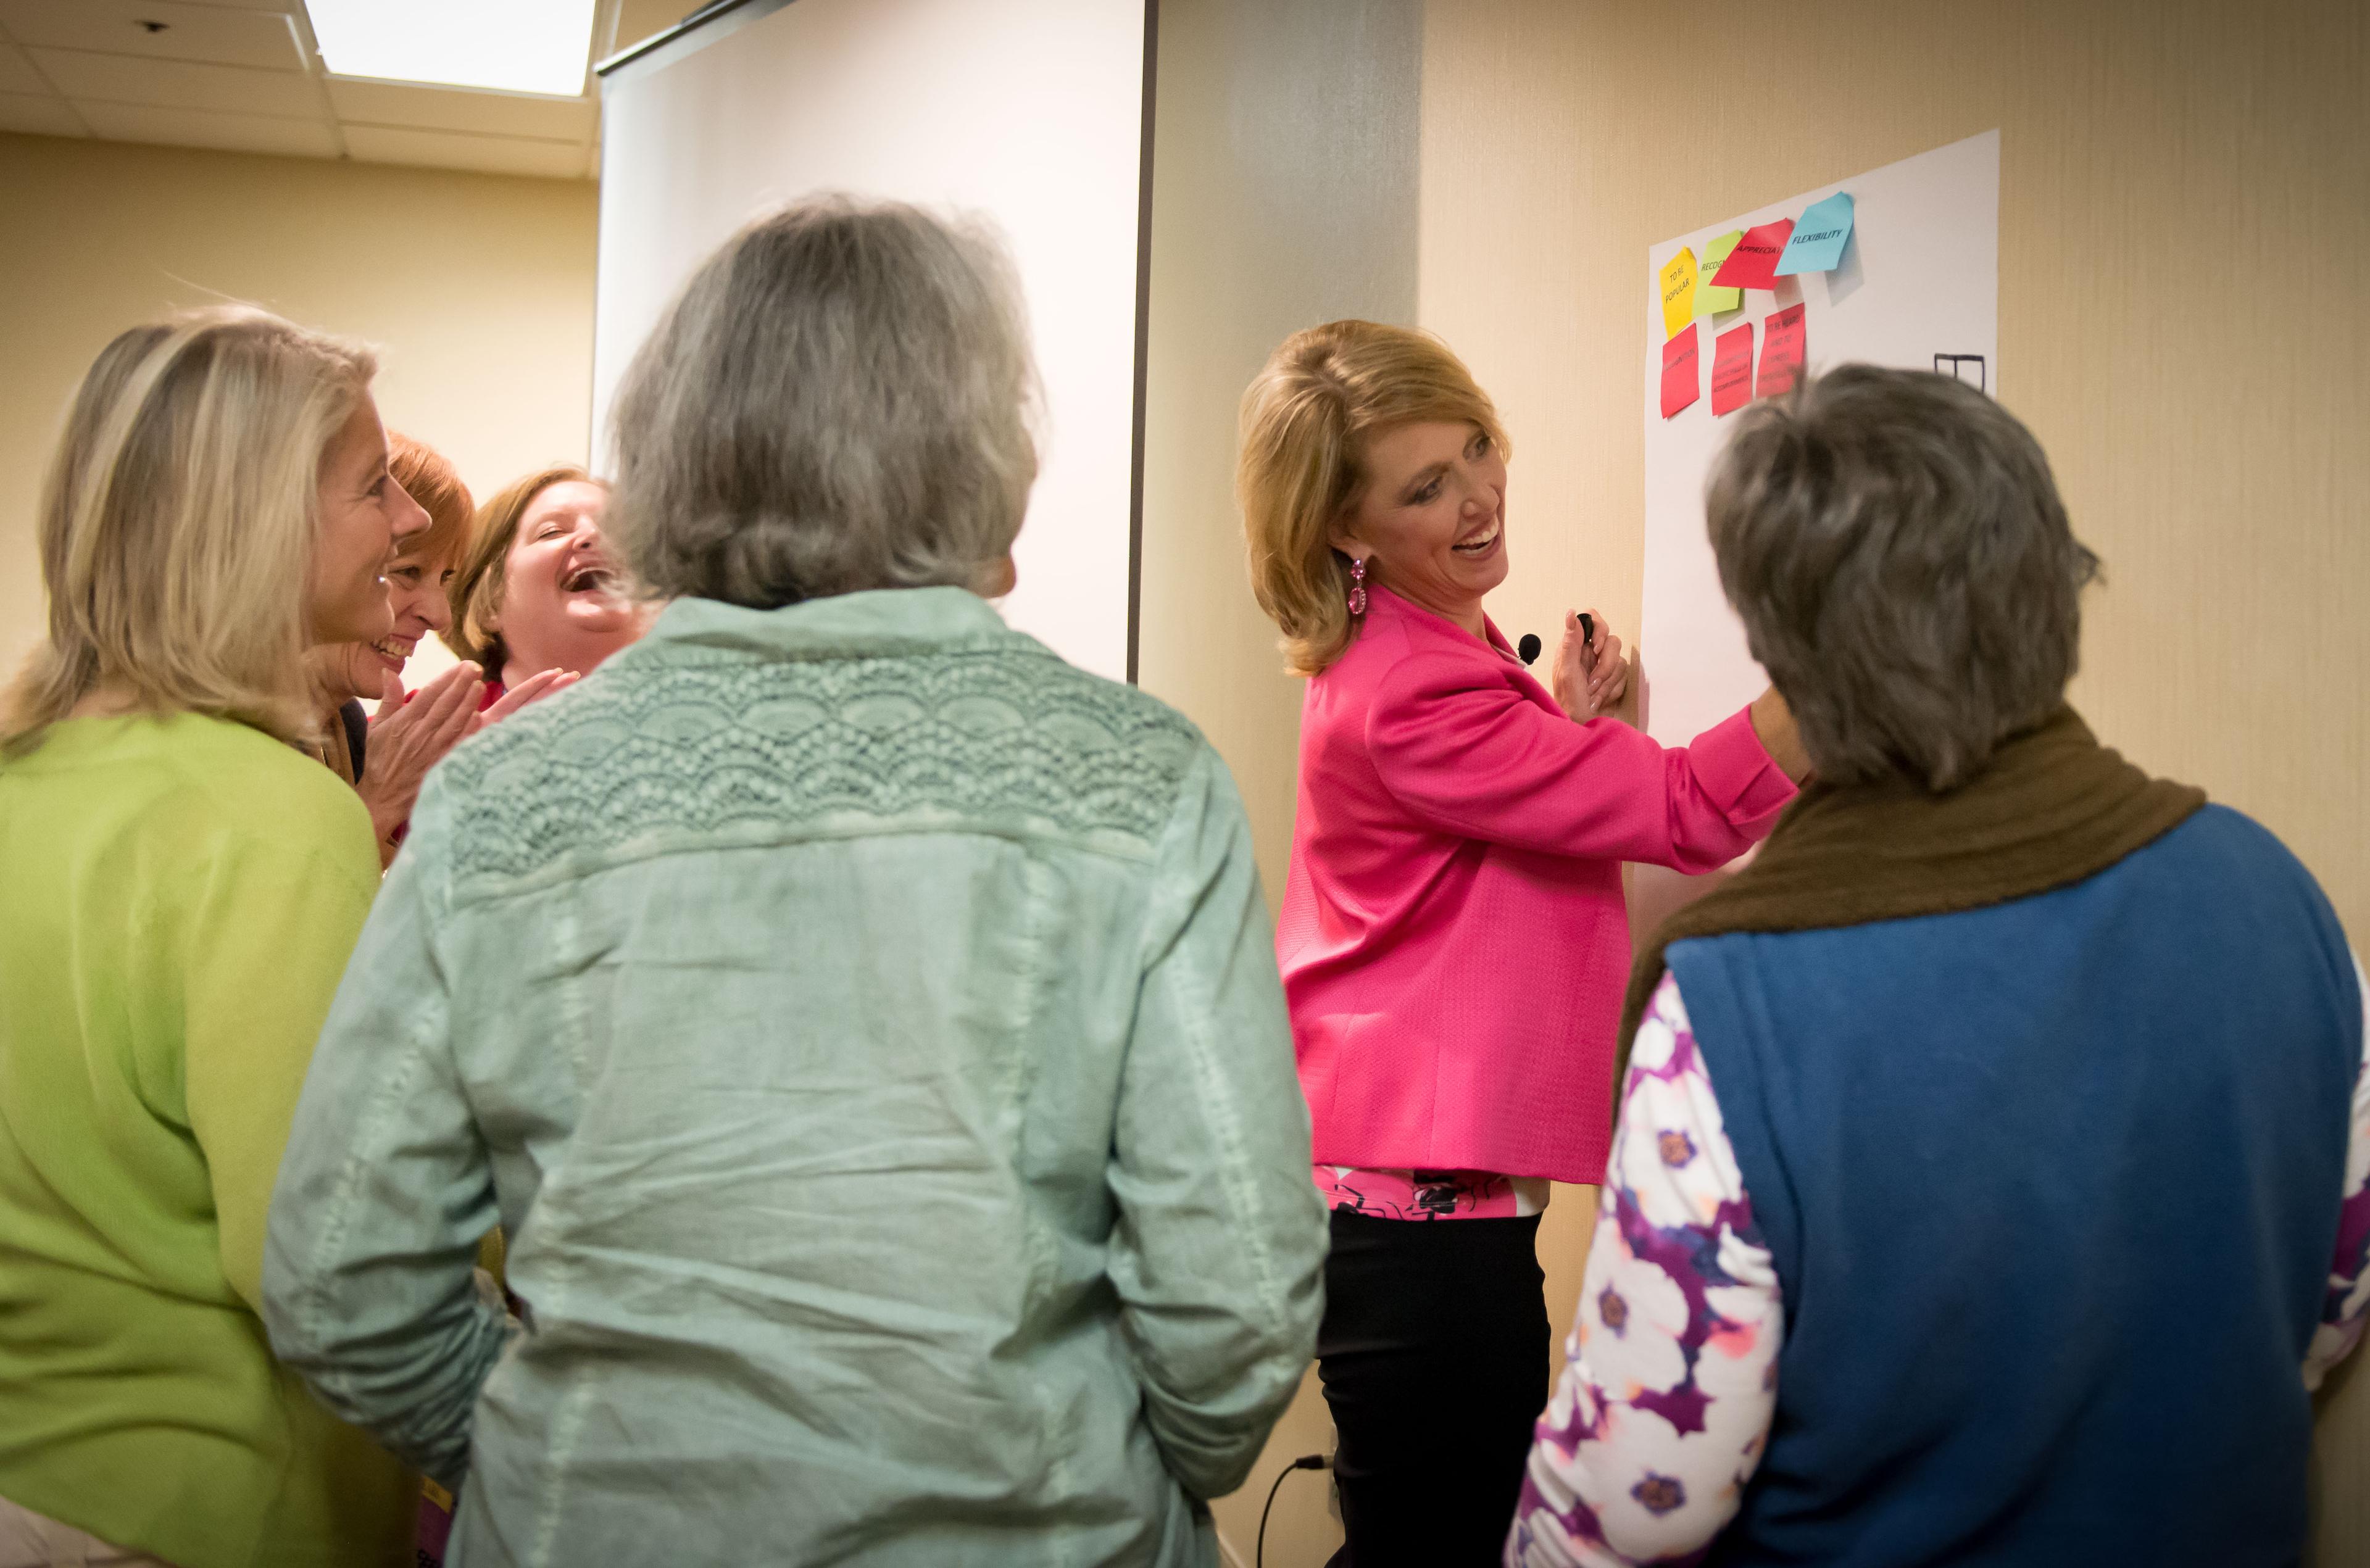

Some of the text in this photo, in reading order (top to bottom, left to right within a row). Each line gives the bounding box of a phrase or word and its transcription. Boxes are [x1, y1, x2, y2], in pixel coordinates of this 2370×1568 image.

[1792, 229, 1843, 244] FLEXIBILITY
[1669, 265, 1684, 283] TO BE
[1665, 278, 1690, 304] POPULAR
